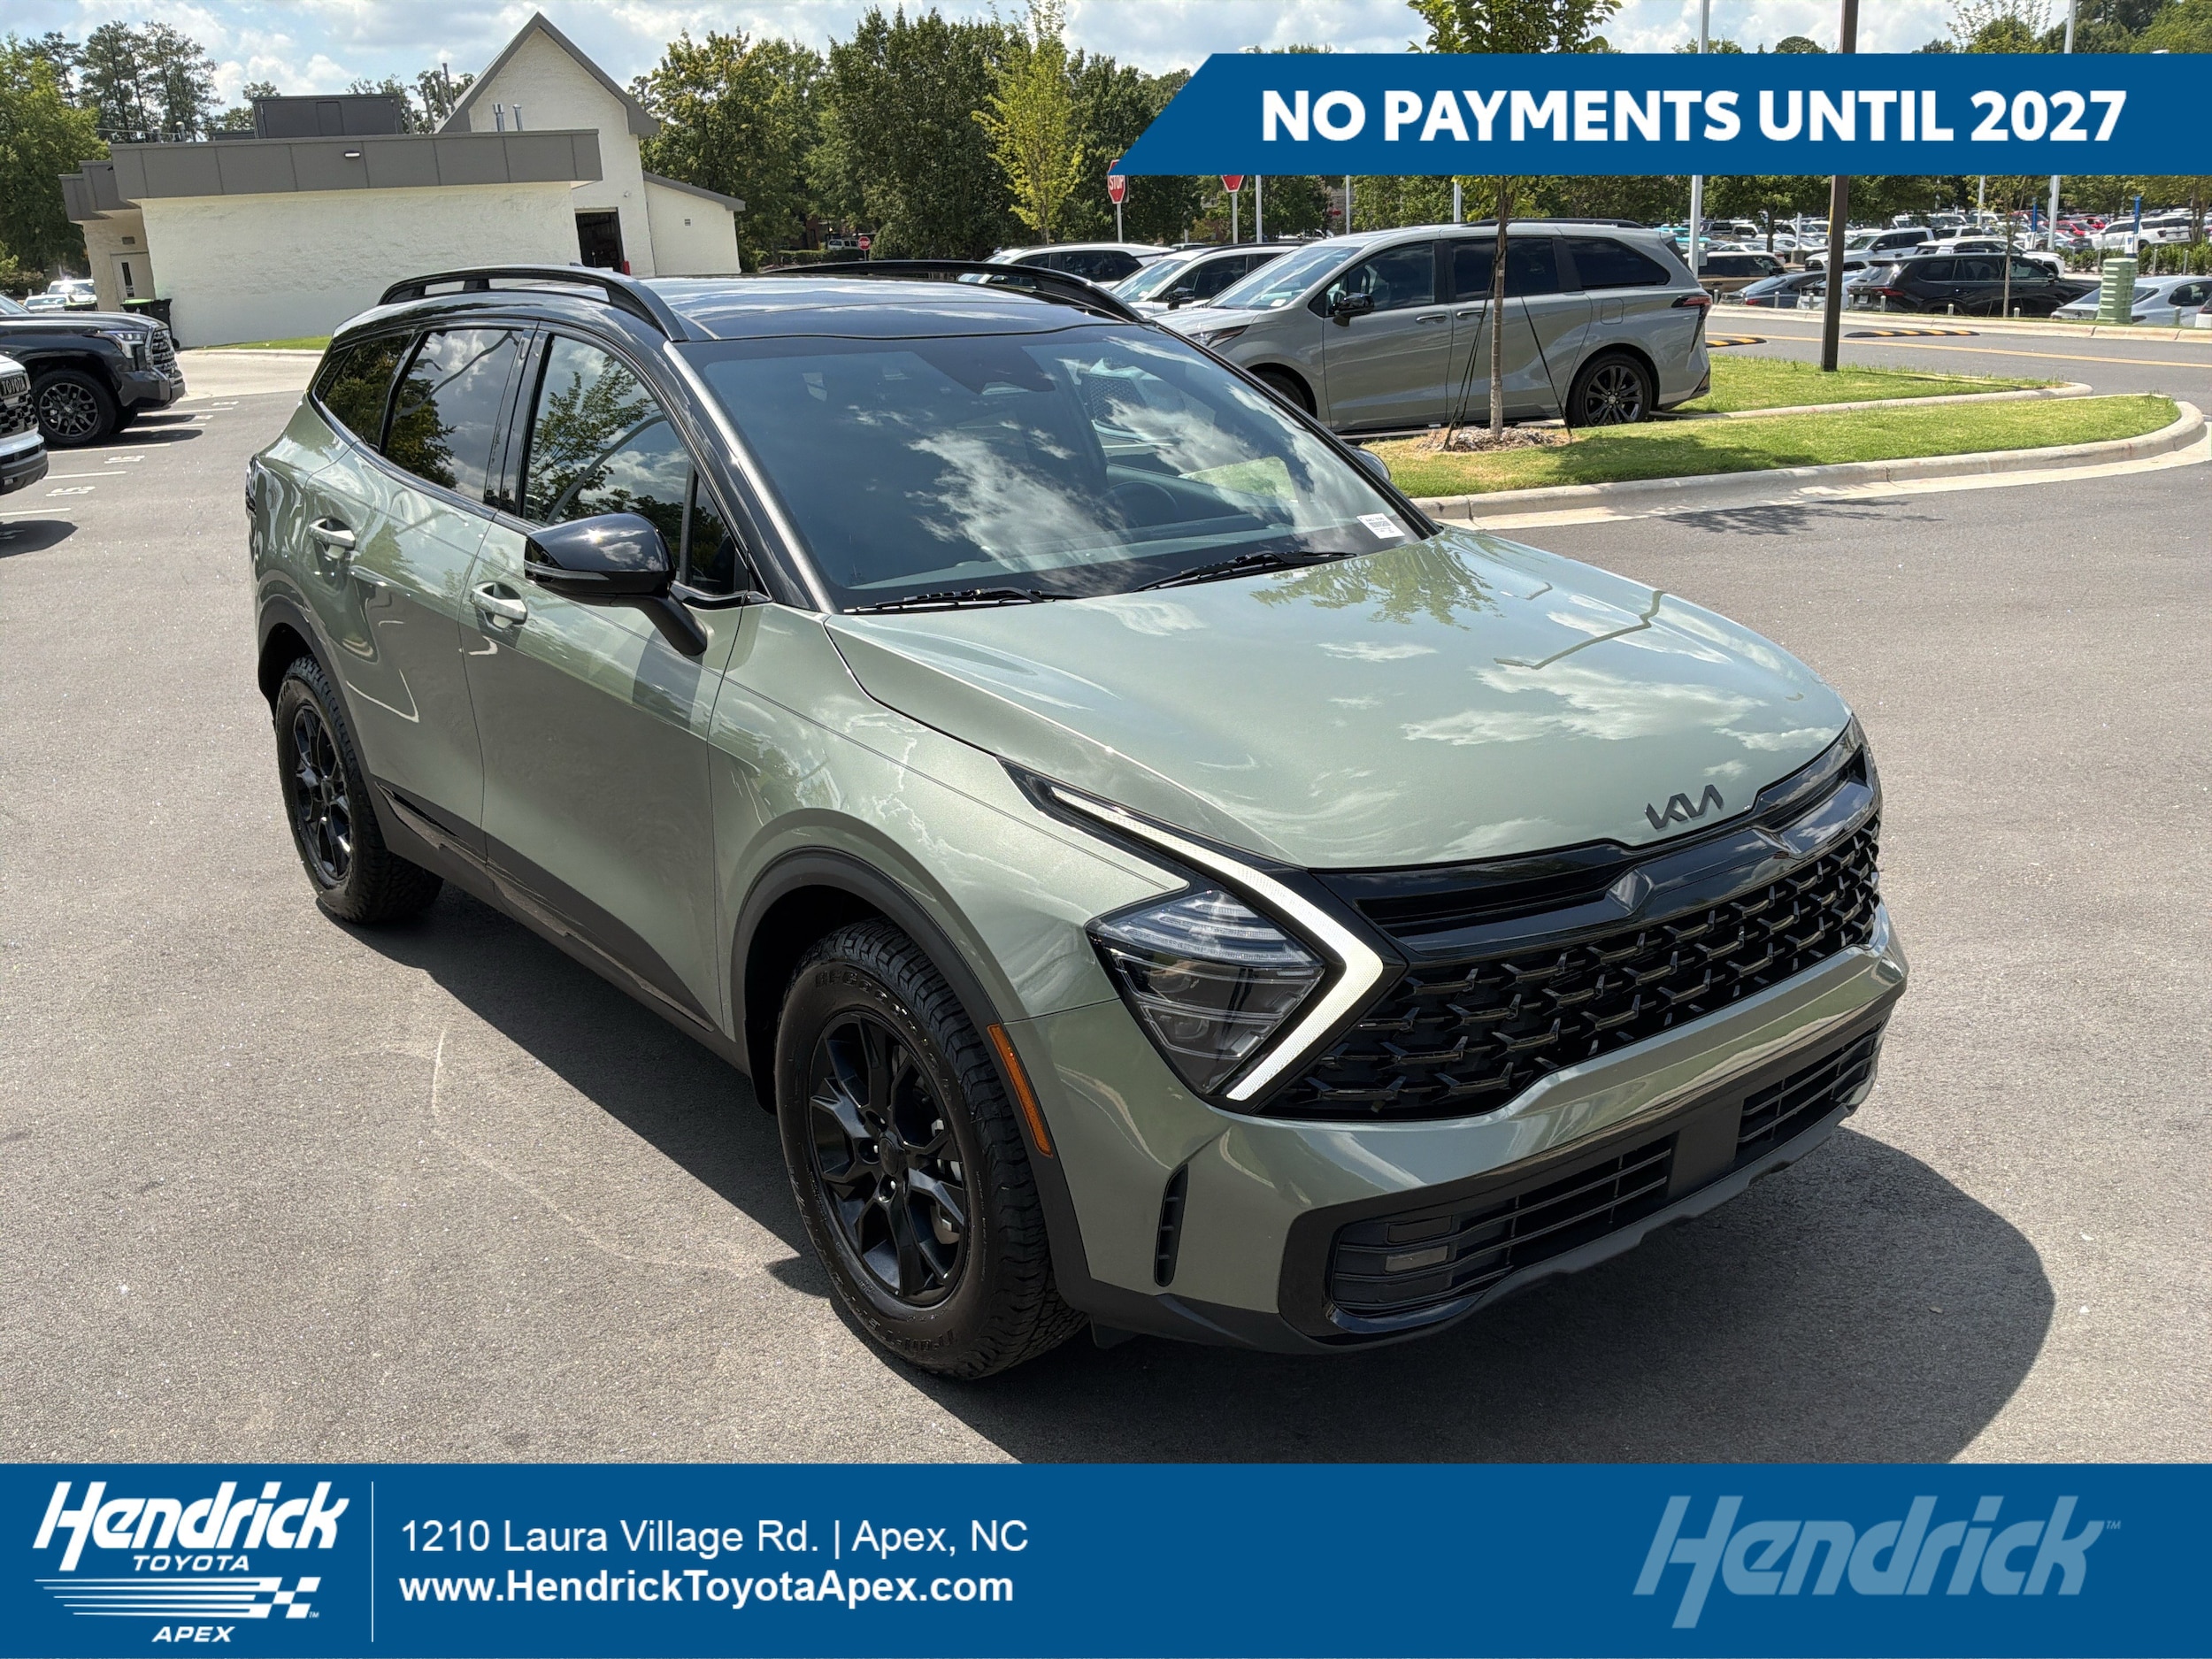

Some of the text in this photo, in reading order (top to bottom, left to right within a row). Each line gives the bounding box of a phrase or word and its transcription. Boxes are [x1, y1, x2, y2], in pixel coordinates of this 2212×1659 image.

[1109, 175, 1124, 190] STOP
[1, 377, 27, 396] TOYOTA
[1645, 784, 1724, 831] KIA
